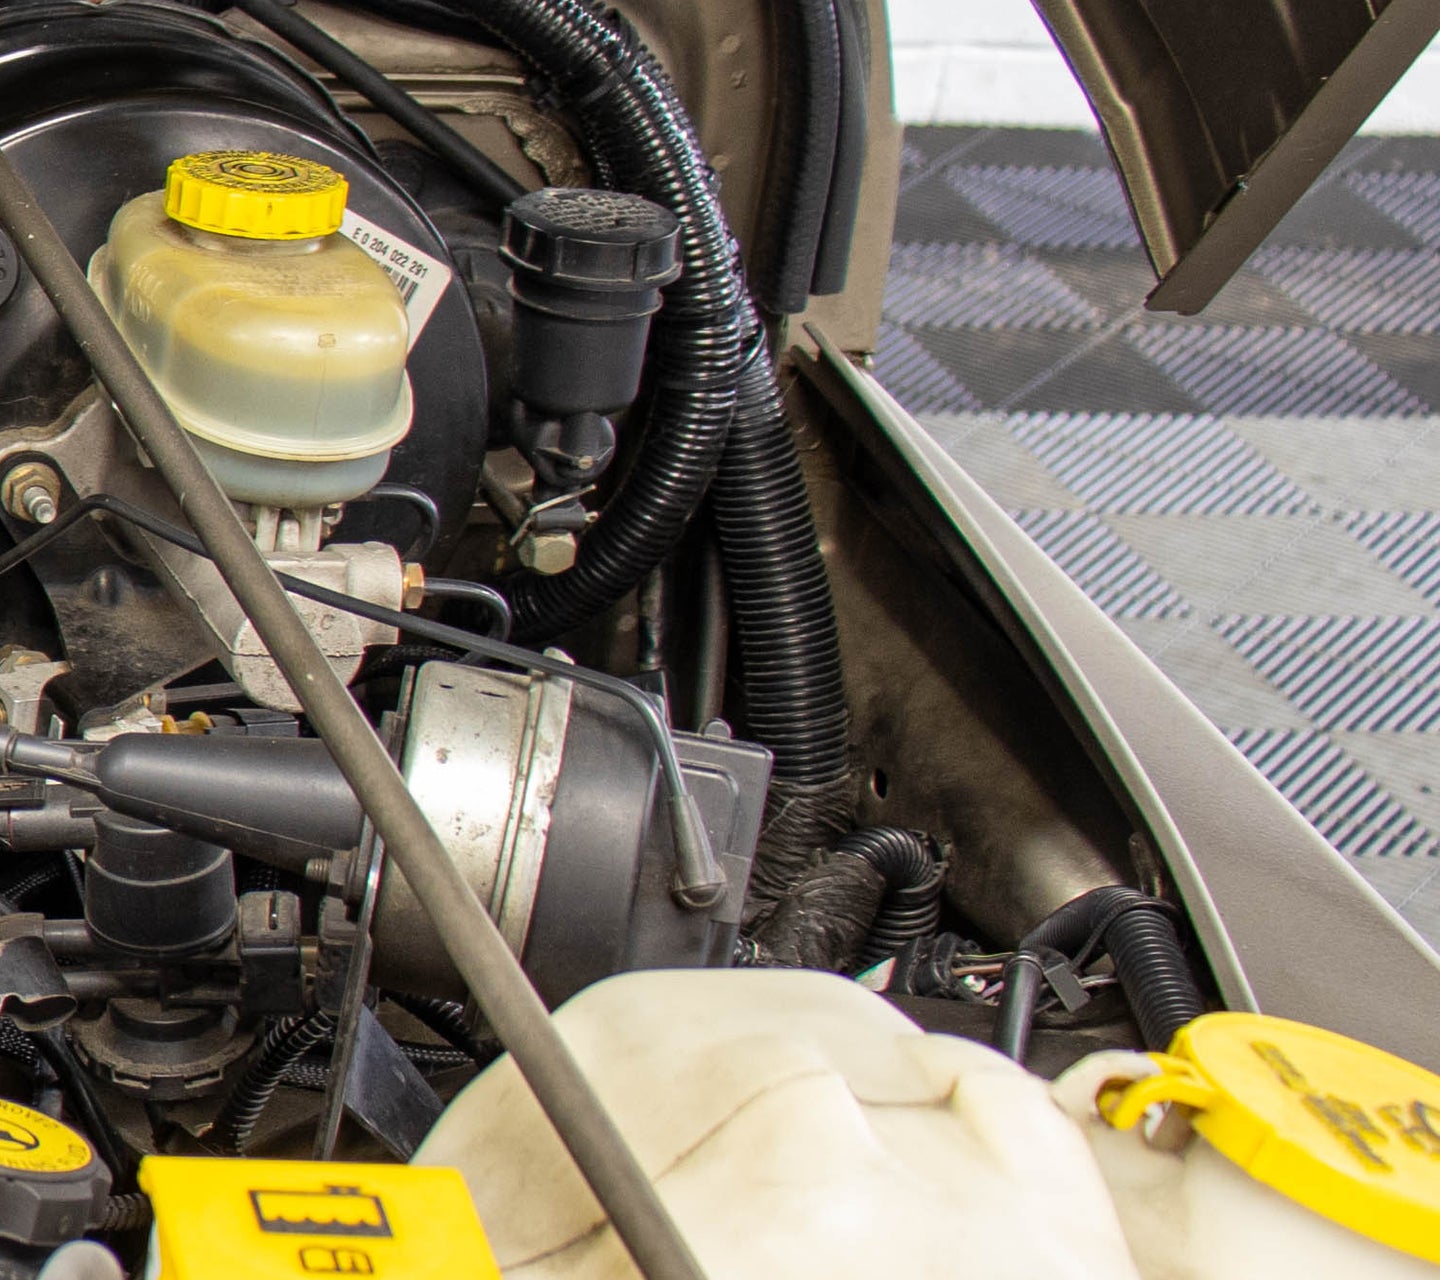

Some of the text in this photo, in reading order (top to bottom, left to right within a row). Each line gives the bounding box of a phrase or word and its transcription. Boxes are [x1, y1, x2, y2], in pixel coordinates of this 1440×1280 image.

[352, 227, 363, 240] E
[370, 238, 390, 256] 204
[389, 249, 410, 268] 022
[408, 261, 429, 278] 291
